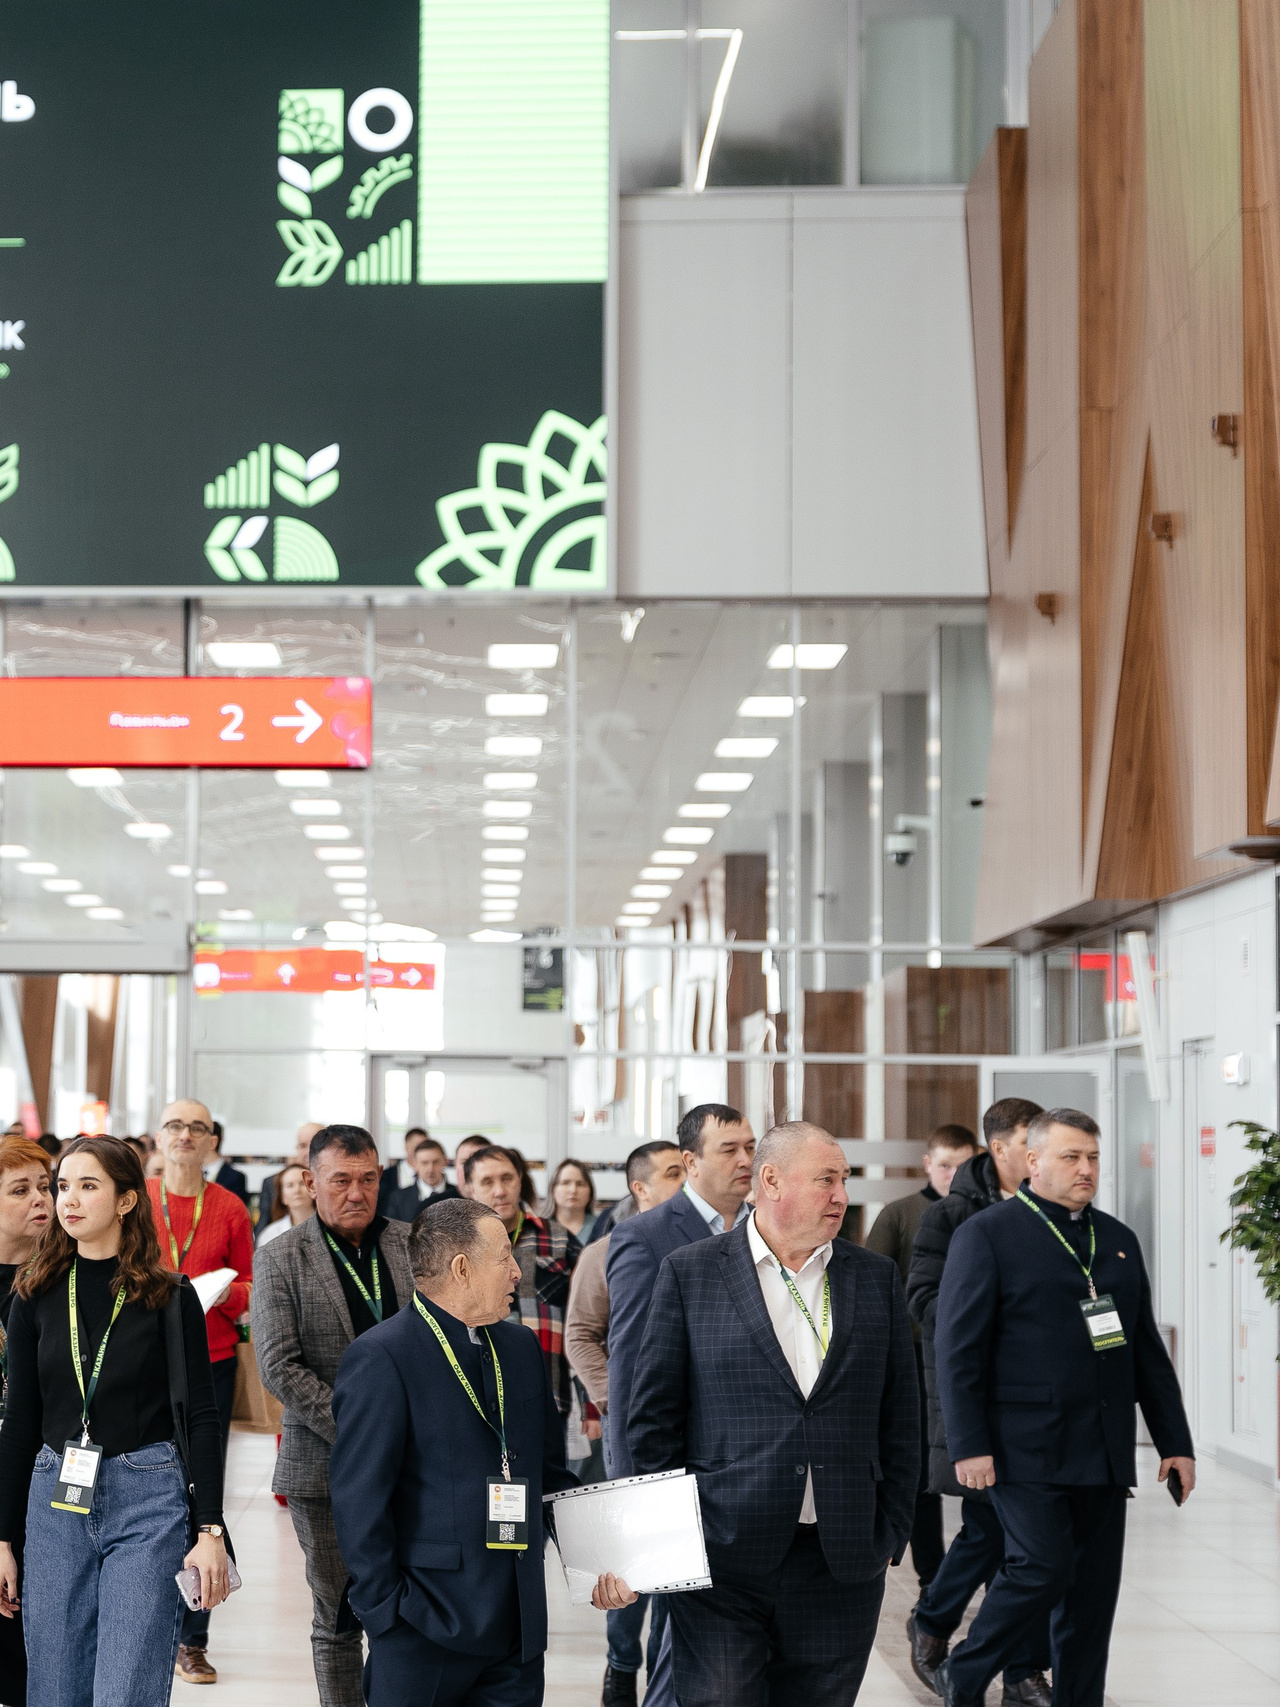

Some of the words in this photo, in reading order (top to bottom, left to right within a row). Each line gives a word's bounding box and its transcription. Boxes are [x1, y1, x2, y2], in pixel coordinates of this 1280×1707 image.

[219, 703, 245, 741] 2
[789, 1283, 806, 1311] КАЗАНЬ
[93, 1343, 105, 1372] КАЗАНЬ
[453, 1363, 466, 1381] АГРО
